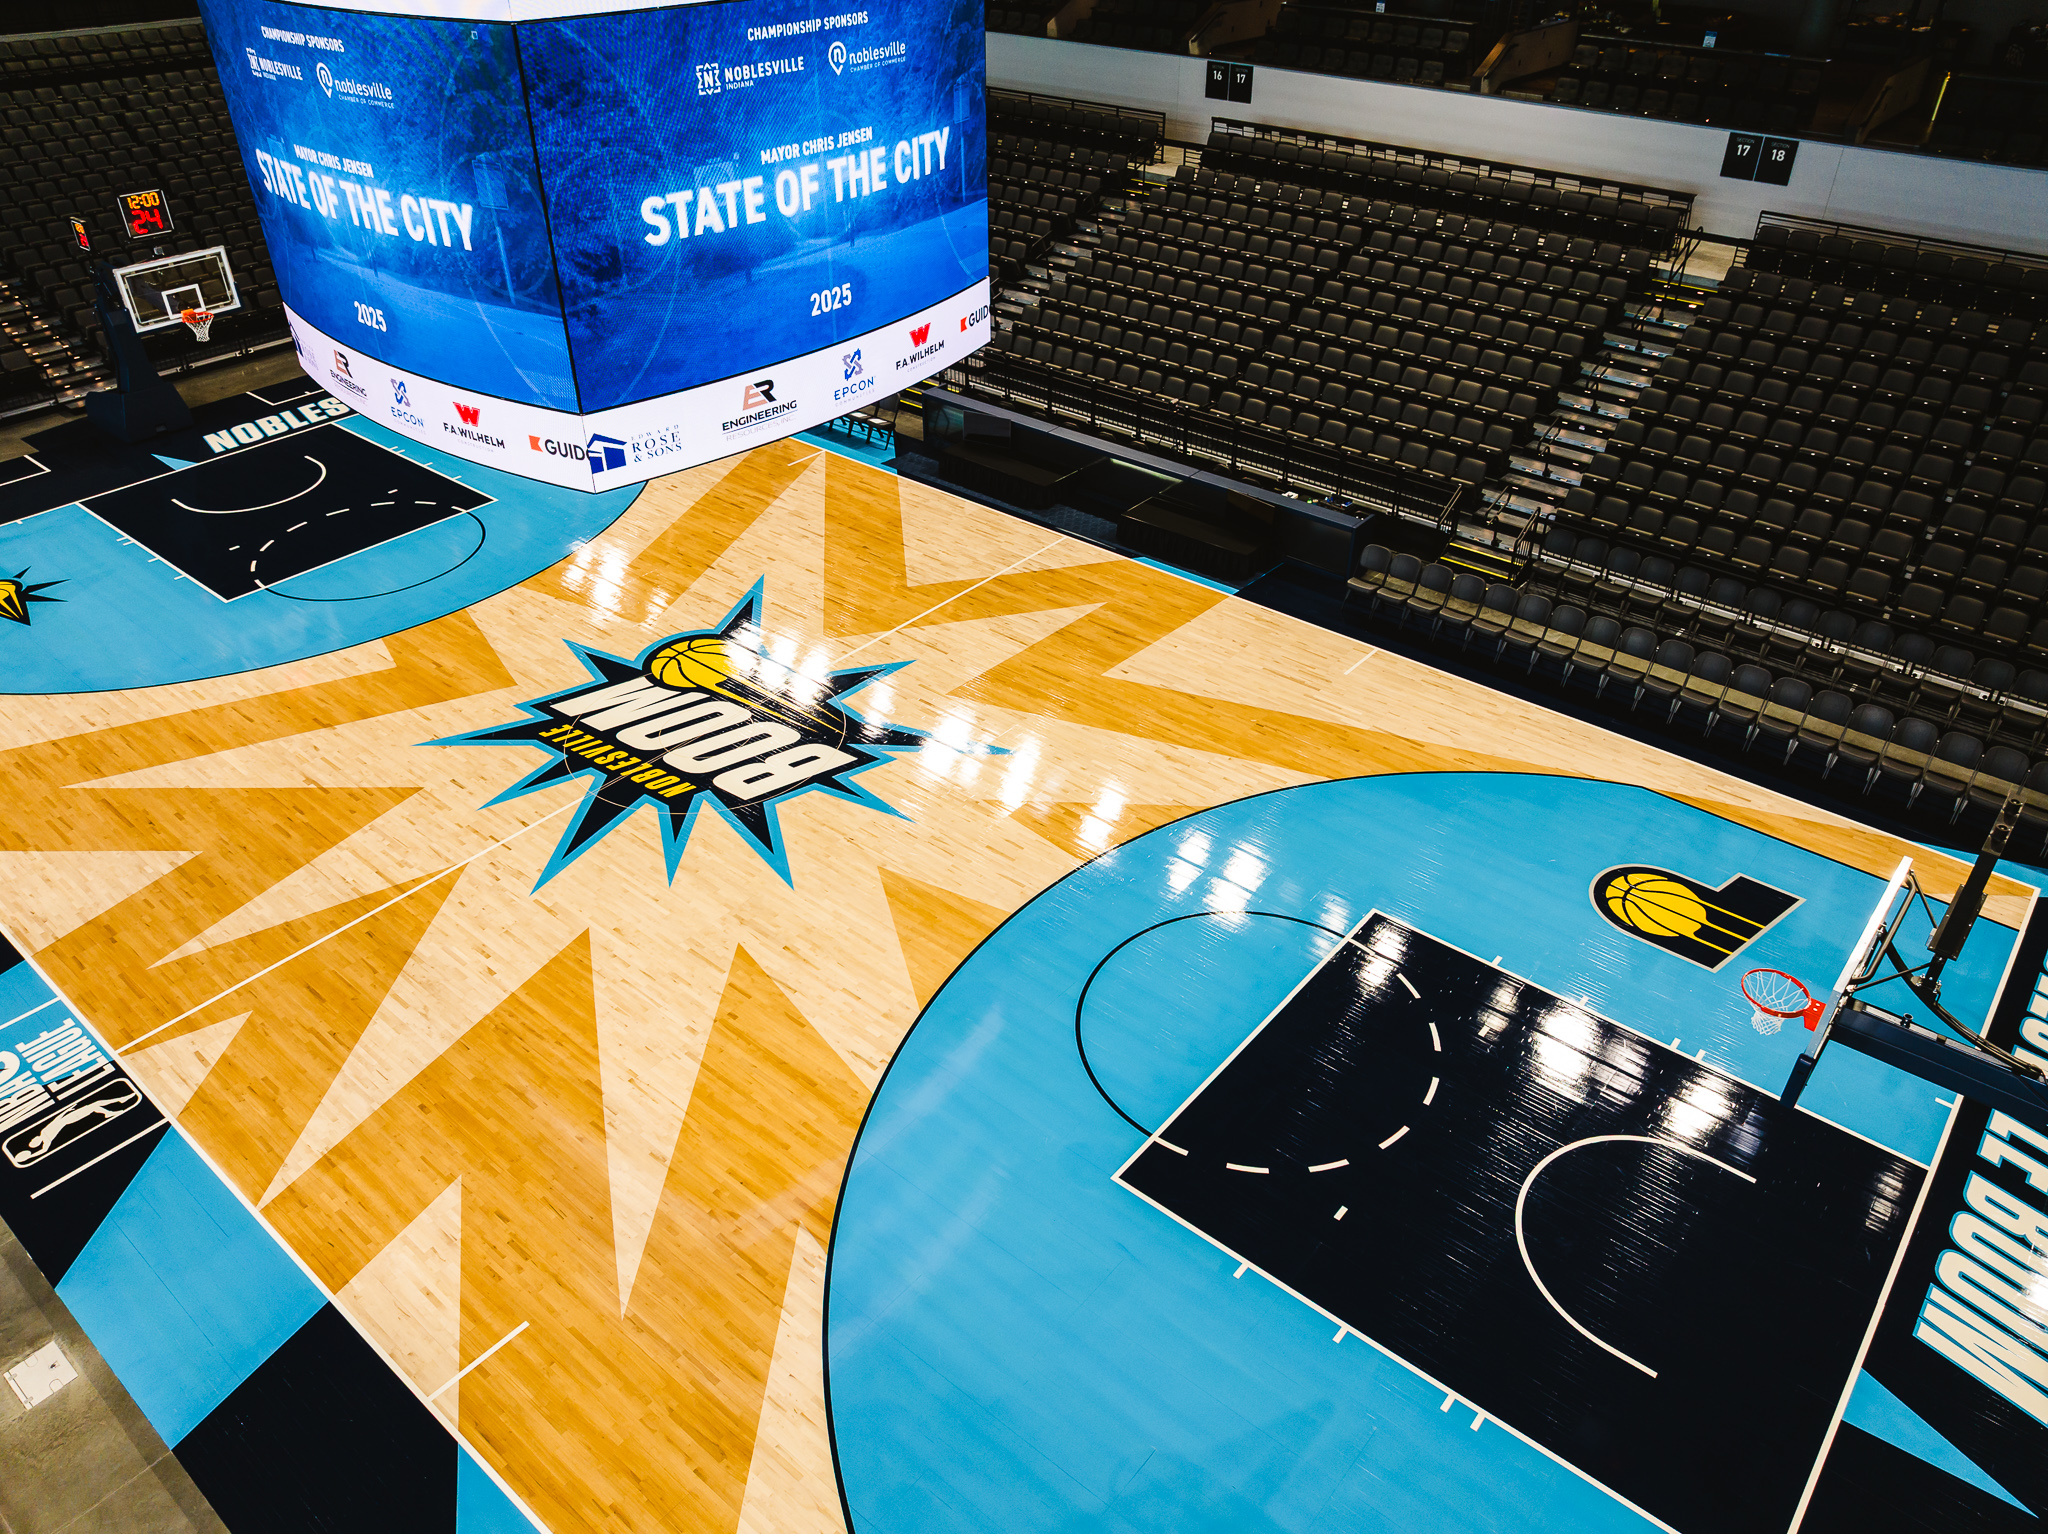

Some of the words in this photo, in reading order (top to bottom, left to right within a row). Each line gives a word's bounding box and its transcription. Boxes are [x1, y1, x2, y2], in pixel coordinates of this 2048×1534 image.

[747, 18, 821, 41] CHAMPIONSHIP
[823, 11, 869, 31] SPONSORS
[260, 25, 305, 46] CHAMPIONSHIP
[305, 34, 345, 53] SPONSORS
[849, 41, 906, 65] noblesville
[849, 64, 874, 73] CHAMBER
[881, 56, 906, 67] COMMERCE
[258, 57, 303, 81] NOBLESVILLE
[724, 56, 804, 82] NOBLESVILLE
[1213, 70, 1222, 80] 16
[1237, 73, 1246, 83] 17
[334, 78, 393, 100] noblesville
[725, 80, 754, 90] INDIANA
[338, 94, 359, 103] CHAMBER
[367, 98, 395, 109] COMMERCE
[760, 143, 800, 166] MAYOR
[802, 136, 835, 157] CHRIS
[837, 126, 873, 149] JENSEN
[1737, 144, 1751, 156] 17
[1771, 149, 1785, 161] 18
[293, 143, 317, 162] MAYOR
[317, 150, 342, 171] CHRIS
[342, 157, 375, 179] JENSEN
[640, 175, 767, 247] STATE
[775, 163, 820, 218] OF
[827, 146, 888, 204] THE
[894, 126, 950, 185] CITY
[127, 191, 161, 210] 12:00
[255, 148, 312, 211] STATE
[308, 170, 339, 220] OF
[338, 180, 400, 237] THE
[400, 193, 473, 252] CITY
[131, 208, 164, 235] 24
[809, 282, 853, 317] 2025
[353, 300, 387, 333] 2025
[968, 304, 991, 327] GUID
[833, 376, 876, 401] EPCON
[390, 405, 425, 428] EPCON
[722, 399, 798, 432] ENGINEERING
[631, 431, 681, 453] ROSE
[634, 453, 642, 463] &
[646, 442, 682, 460] SONS
[550, 676, 858, 800] BOOM
[538, 723, 698, 799] NOBLESVILLE
[14, 1017, 116, 1101] LEAGUE
